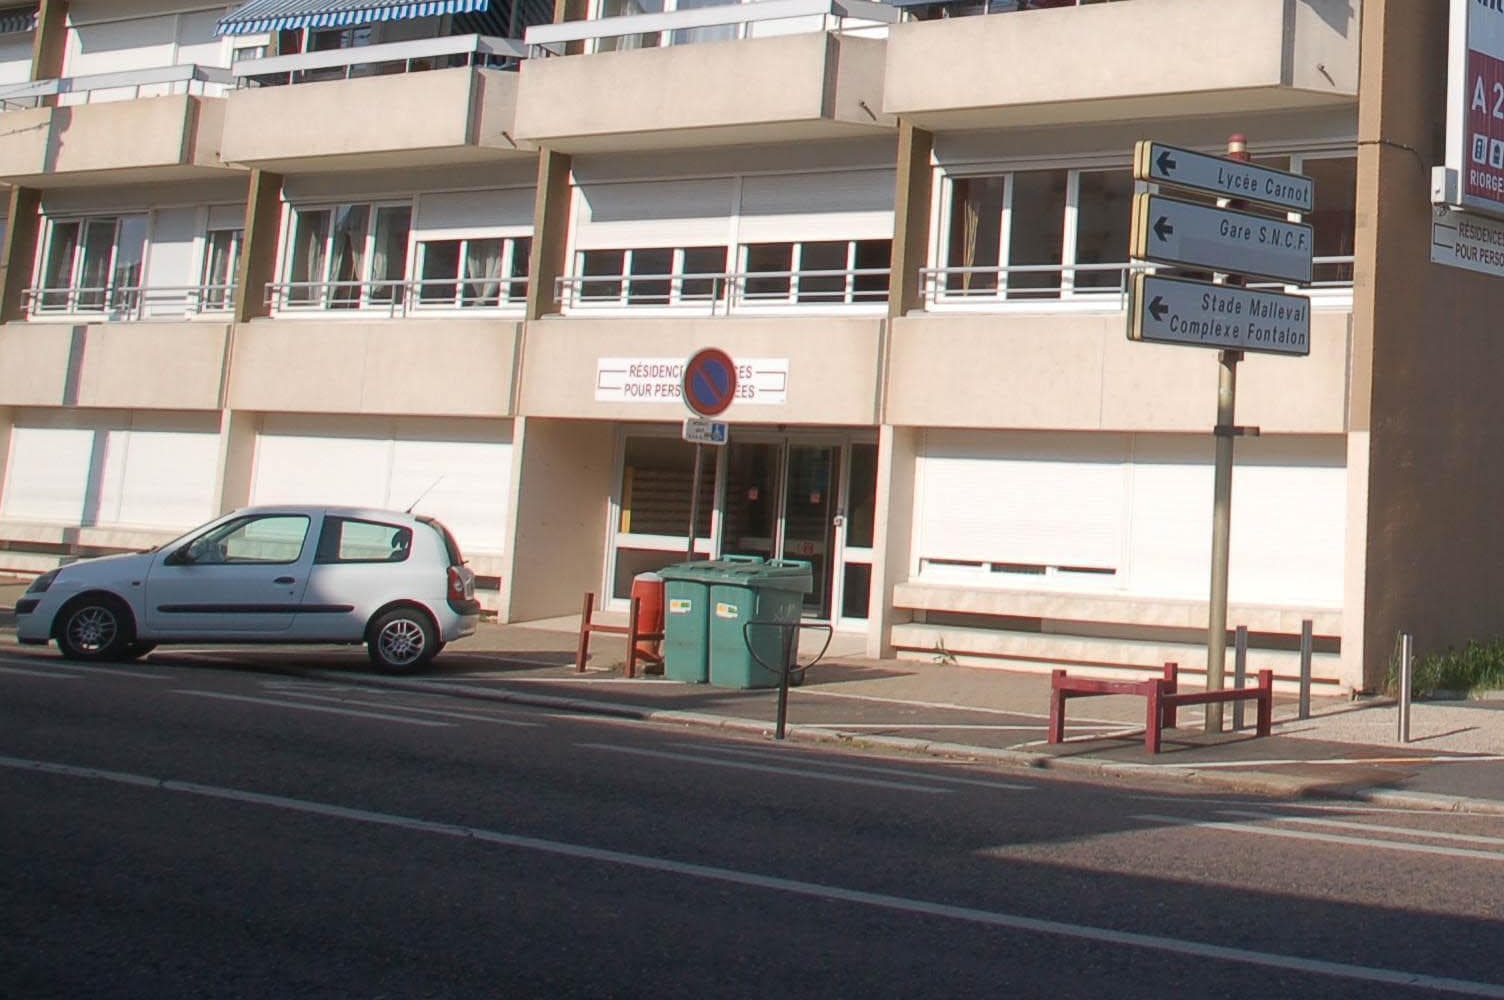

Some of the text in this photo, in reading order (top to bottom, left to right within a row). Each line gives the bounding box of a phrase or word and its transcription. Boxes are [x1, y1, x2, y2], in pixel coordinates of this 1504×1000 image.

[1472, 75, 1487, 115] A
[1492, 81, 1504, 120] 2
[1218, 167, 1309, 203] Lycée Carnot
[1220, 218, 1308, 251] Gare S.N.C.F.
[1455, 241, 1478, 262] POUR
[1202, 292, 1305, 322] Stade Malleval
[1169, 314, 1306, 345] Complexe Fontalon
[624, 383, 652, 397] POUR
